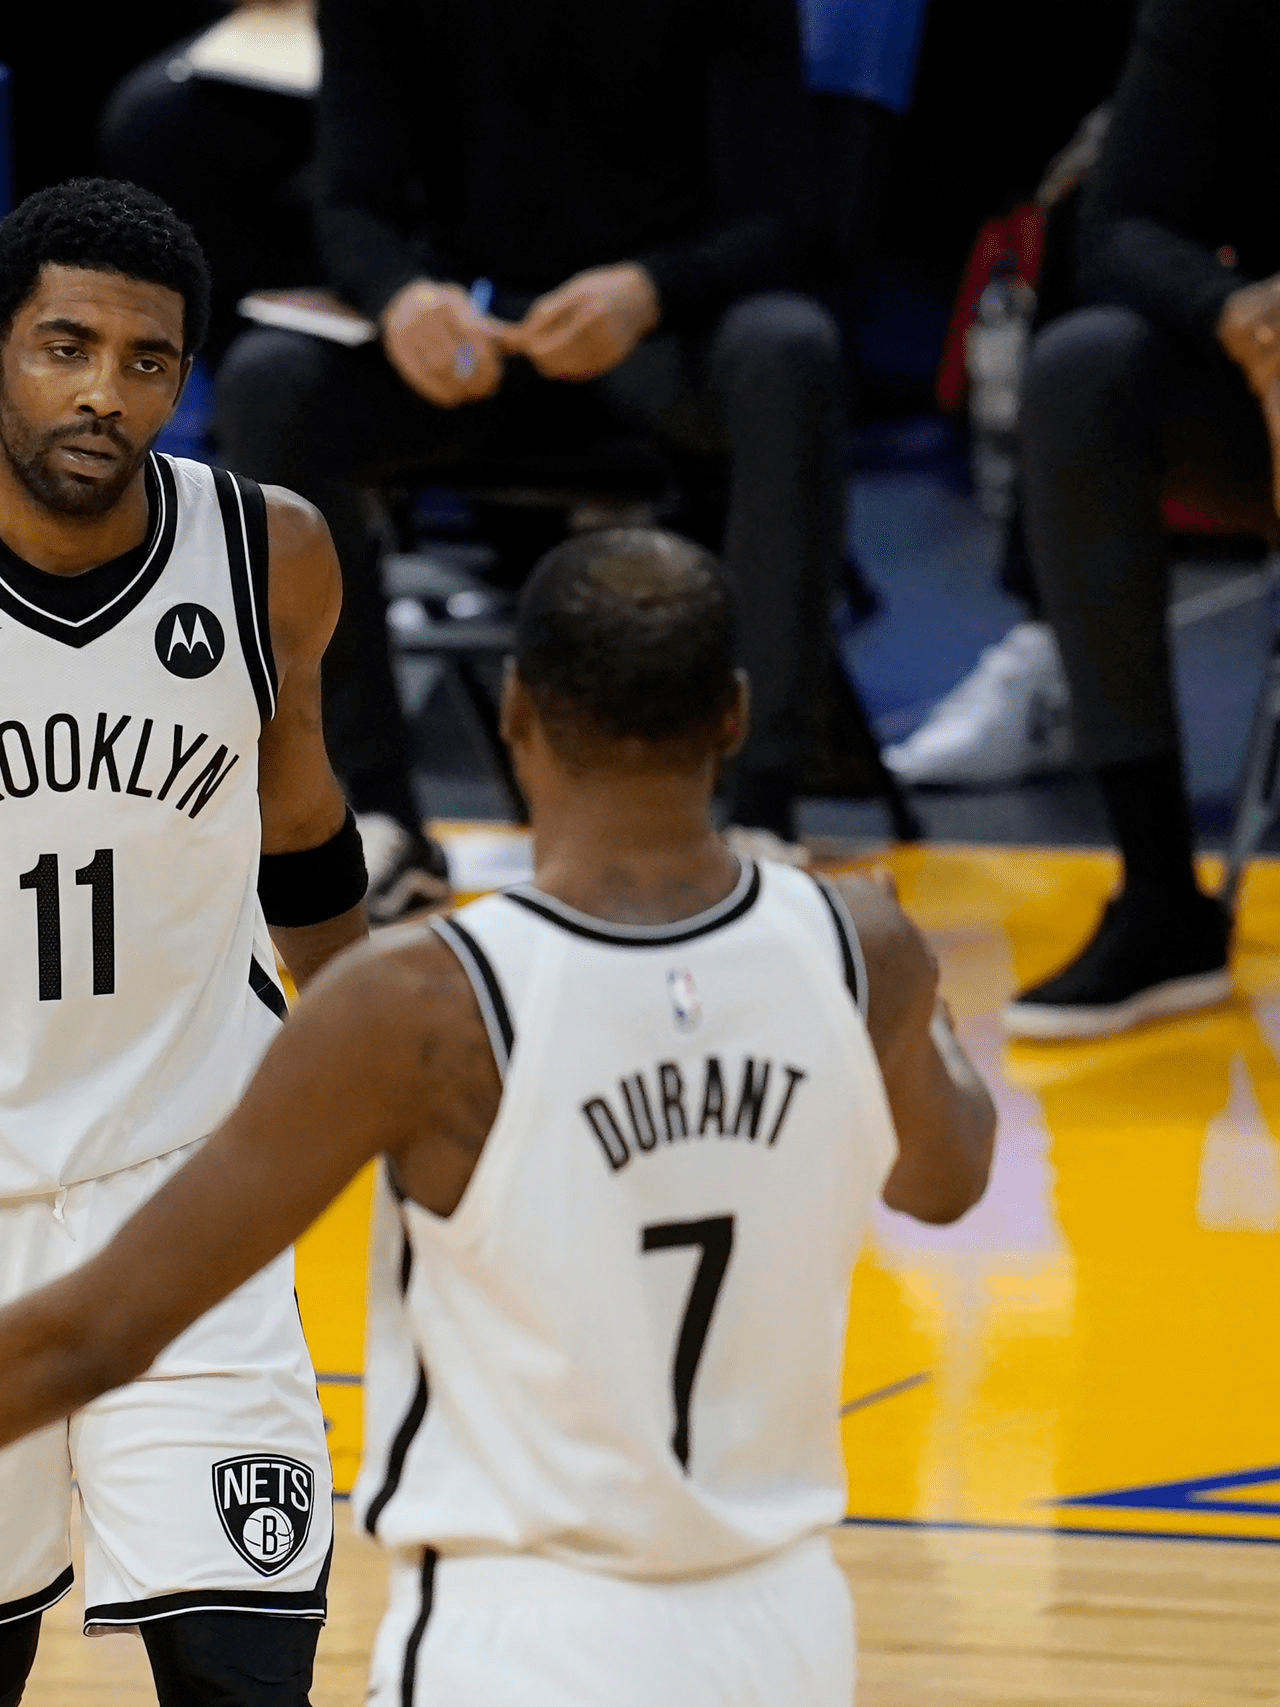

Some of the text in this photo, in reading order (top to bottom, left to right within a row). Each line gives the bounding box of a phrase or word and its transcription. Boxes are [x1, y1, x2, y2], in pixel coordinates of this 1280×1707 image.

[20, 849, 115, 1001] 11
[579, 1053, 809, 1174] DURANT
[640, 1213, 737, 1475] 7
[223, 1463, 309, 1512] NETS
[262, 1515, 278, 1556] B
